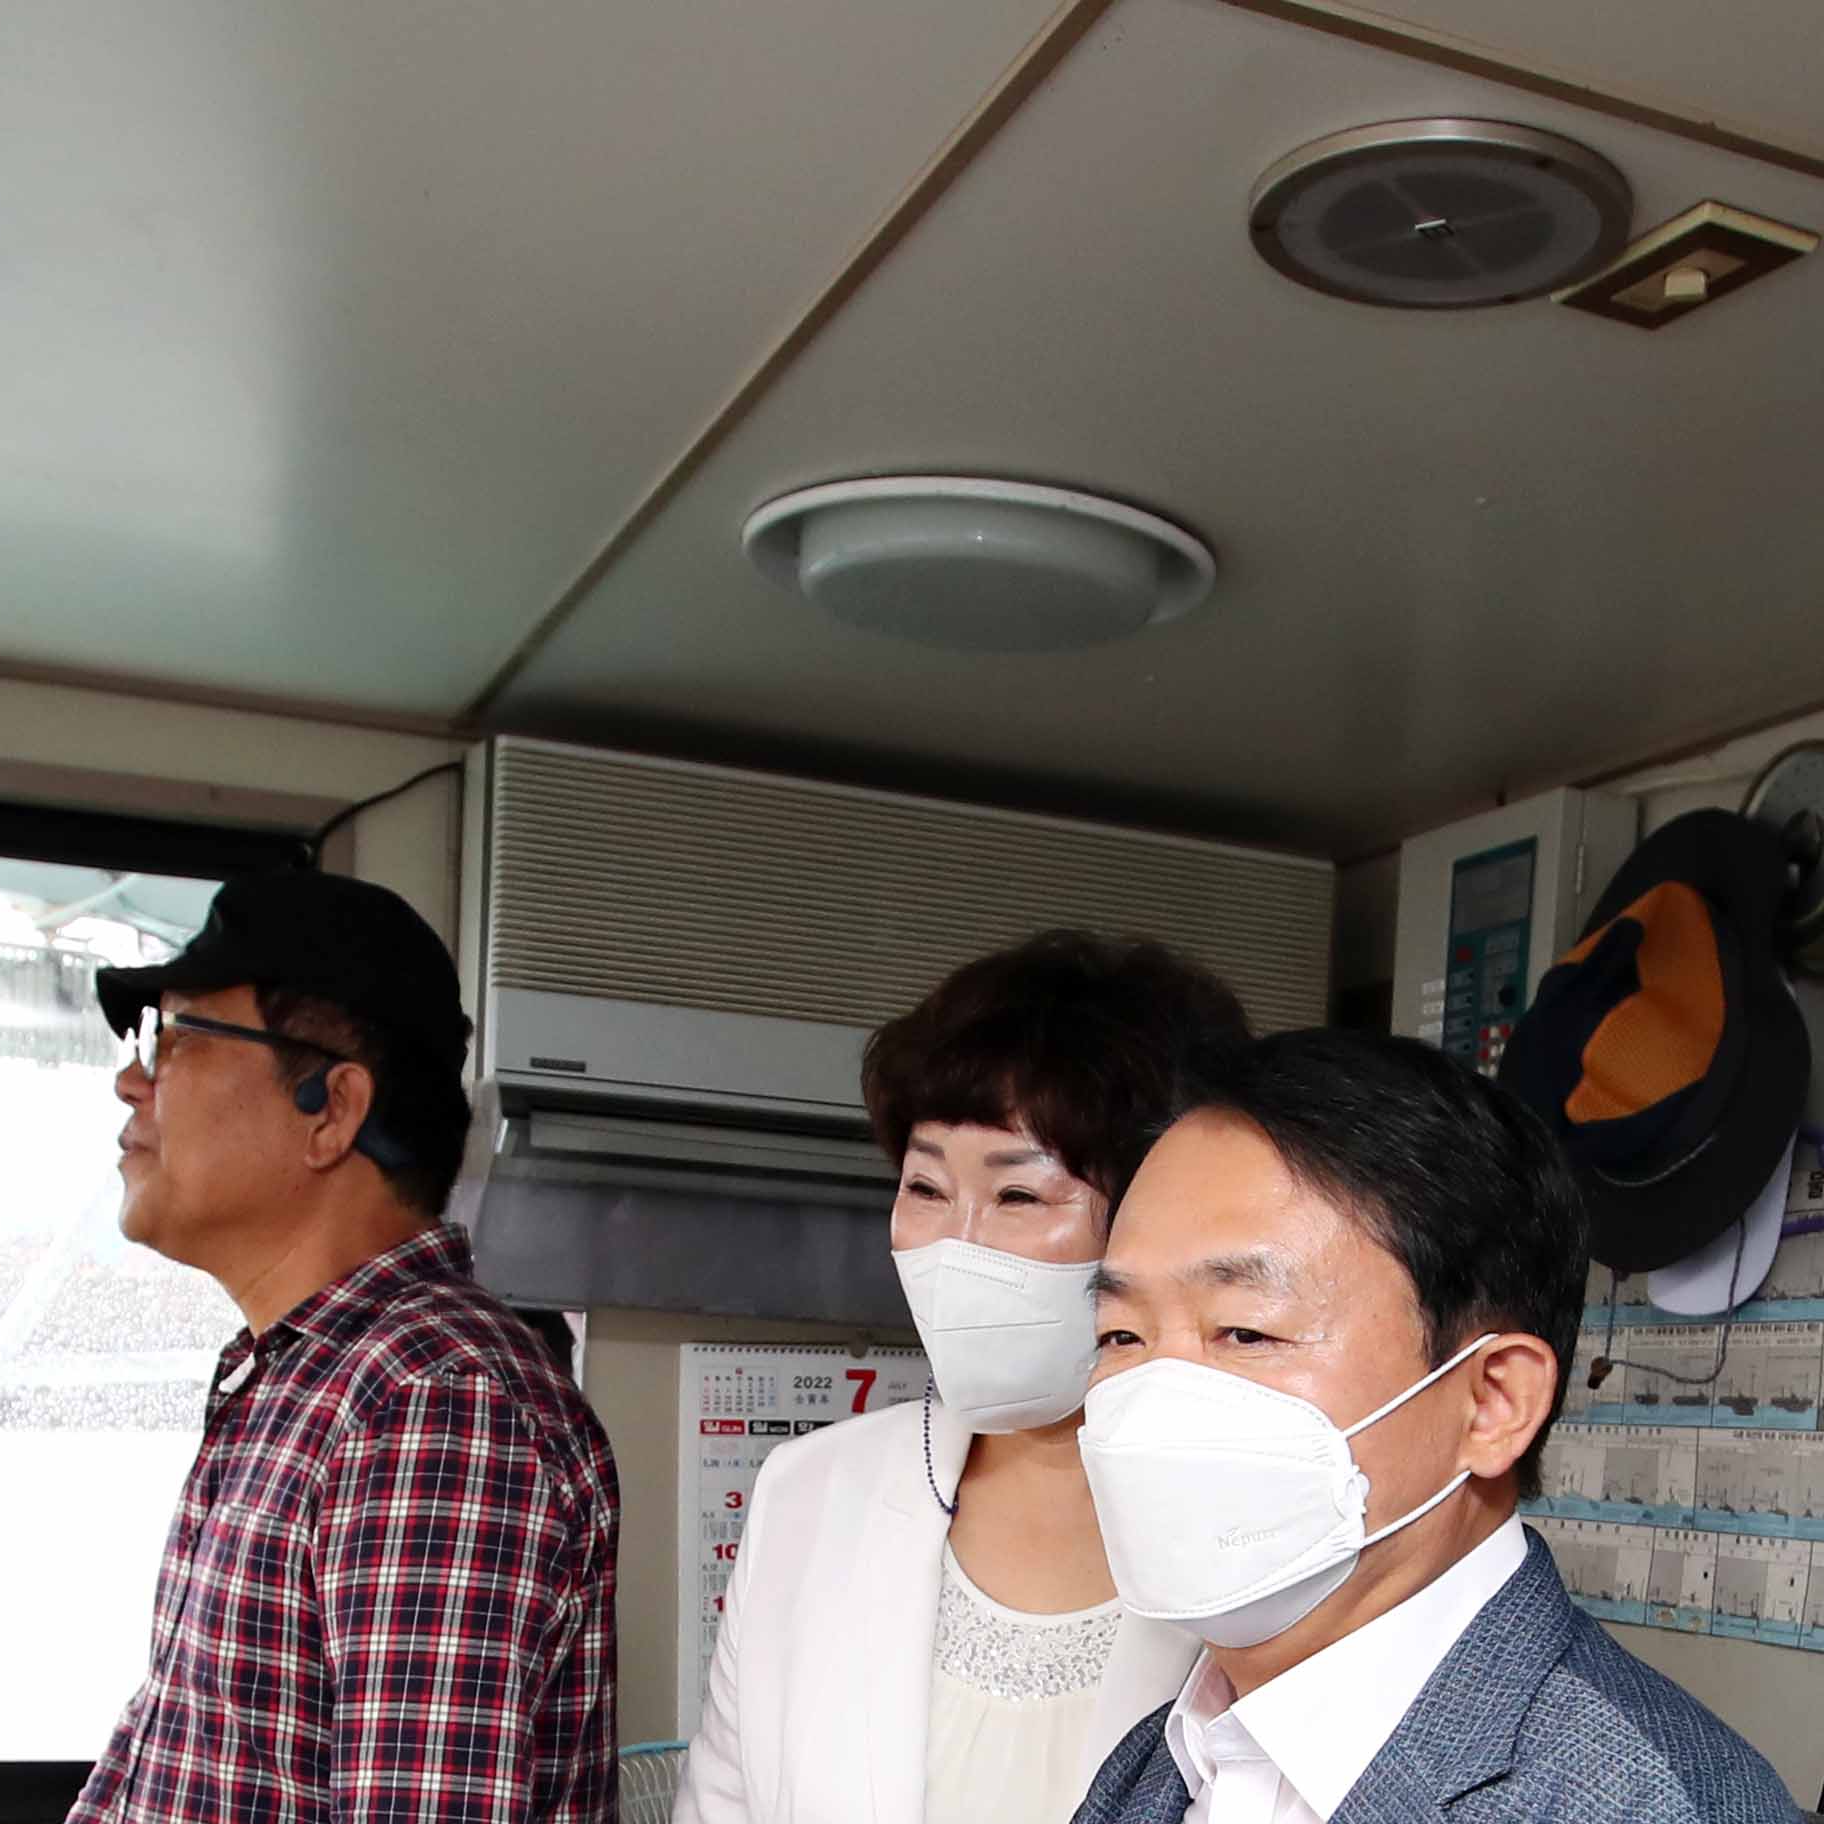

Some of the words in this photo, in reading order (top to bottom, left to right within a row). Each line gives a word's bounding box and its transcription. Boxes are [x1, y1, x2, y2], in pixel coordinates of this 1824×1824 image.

[793, 1376, 832, 1389] 2022
[846, 1369, 876, 1413] 7
[725, 1491, 744, 1509] 3
[713, 1543, 738, 1561] 10
